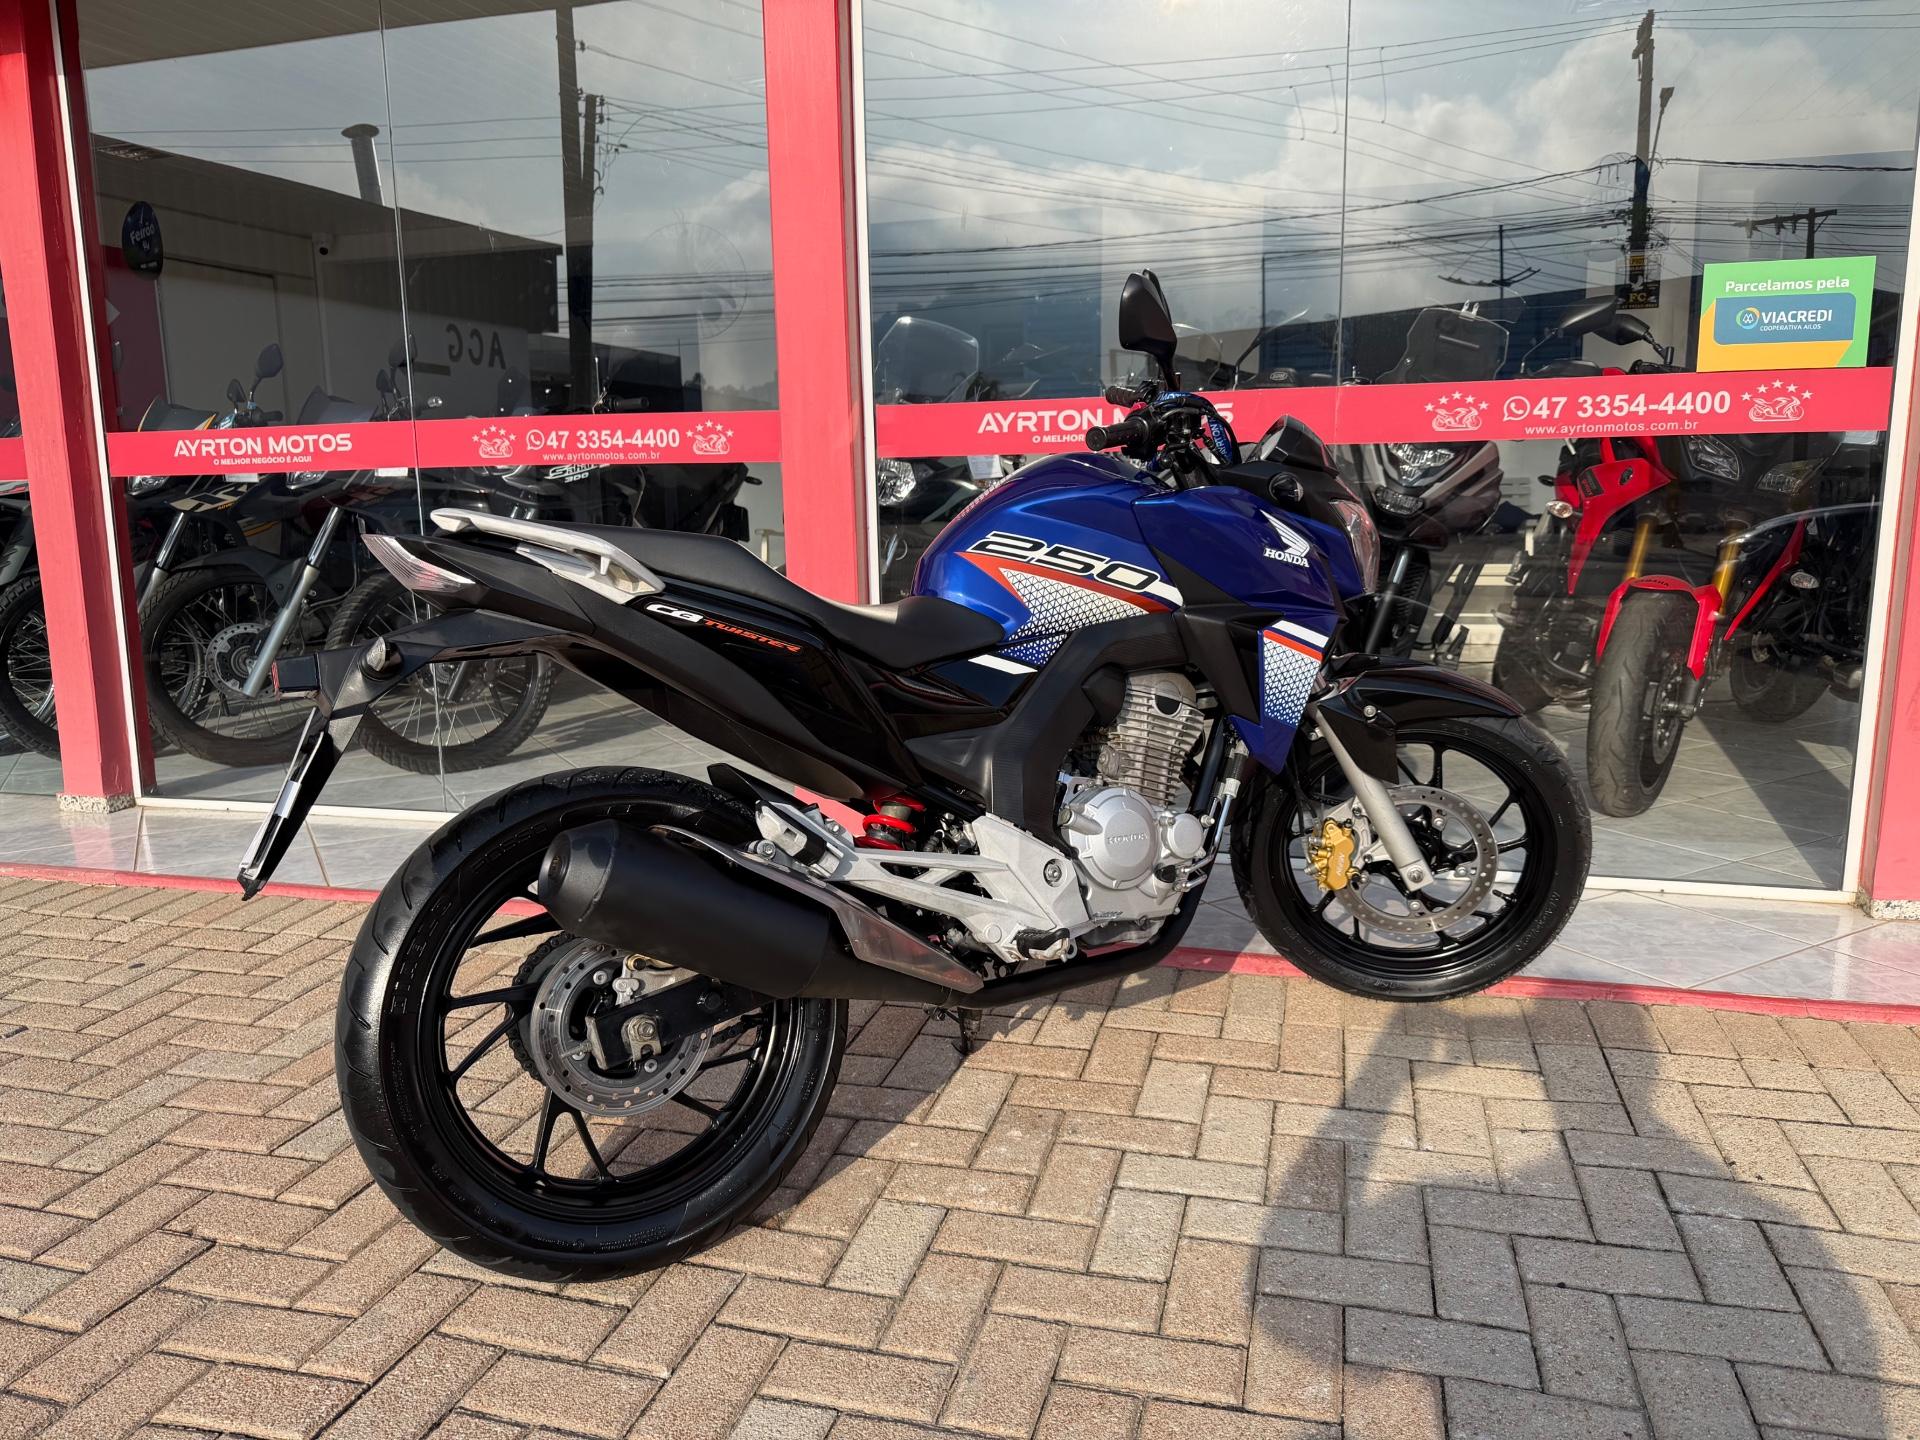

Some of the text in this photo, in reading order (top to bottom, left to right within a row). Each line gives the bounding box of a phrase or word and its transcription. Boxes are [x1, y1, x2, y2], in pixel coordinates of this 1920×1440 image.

[1725, 276, 1850, 292] Parcelamos pela
[1761, 309, 1833, 324] VIACREDI
[1760, 324, 1802, 332] COOPERATIVA
[1532, 391, 1731, 419] 47 3354-4400
[977, 408, 1103, 434] AYRTON
[1525, 420, 1699, 435] www.ayrtonmotos.com.br
[174, 433, 353, 457] AYRTON MOTOS
[546, 428, 680, 449] 47 3354-4400
[1032, 433, 1084, 444] O MELHOR
[213, 454, 312, 466] O MELHOR NEGÓCIO É AQUI
[542, 450, 661, 462] www.ayrtonmotos.com.br
[564, 472, 590, 484] 300
[967, 531, 1160, 592] 250
[1263, 547, 1310, 568] HONDA
[646, 603, 801, 652] CB TWISTER
